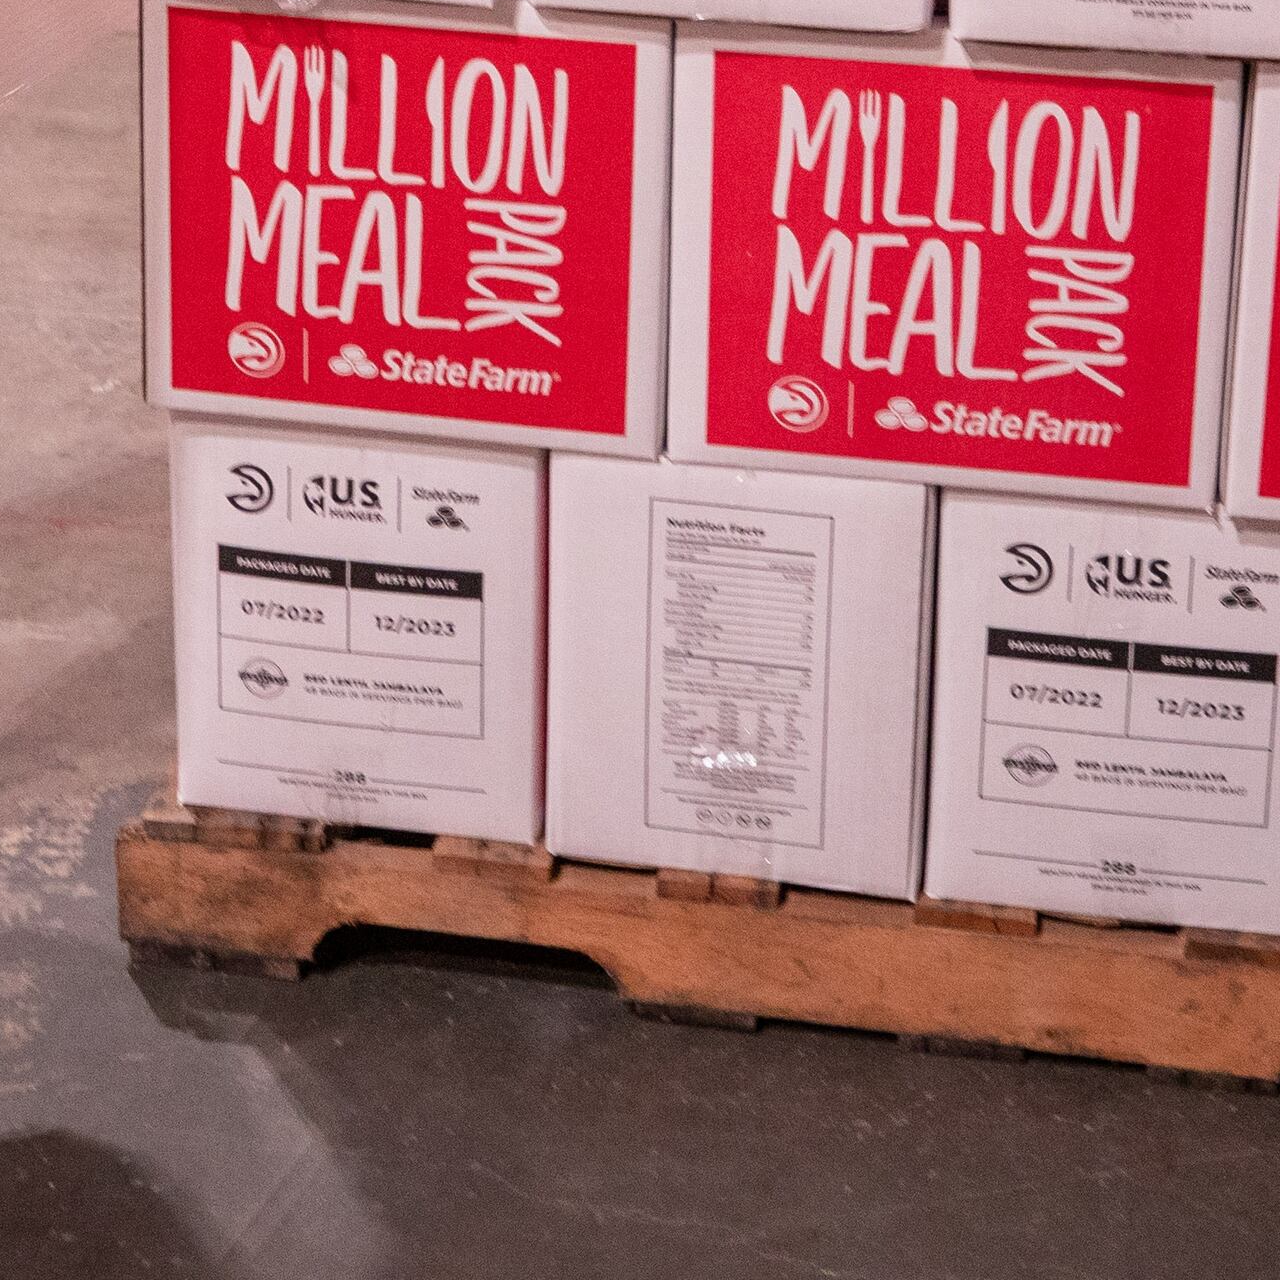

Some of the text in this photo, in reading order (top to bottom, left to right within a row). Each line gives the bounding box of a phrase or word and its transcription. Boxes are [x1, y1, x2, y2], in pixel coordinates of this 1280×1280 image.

[225, 39, 569, 197] MILLION
[771, 83, 1141, 243] MILLION
[225, 174, 463, 332] MEAL
[462, 196, 568, 349] PACK
[765, 223, 1020, 383] MEAL
[1020, 244, 1136, 399] PACK
[301, 564, 331, 578] DATE
[376, 572, 458, 592] BEST BY DATE
[240, 597, 325, 625] 07/2022
[374, 612, 455, 639] 12/2023
[1078, 646, 1112, 661] DATE
[1161, 654, 1251, 674] BEST BY DATE
[1009, 681, 1103, 709] 07/2022
[1156, 695, 1245, 723] 12/2023
